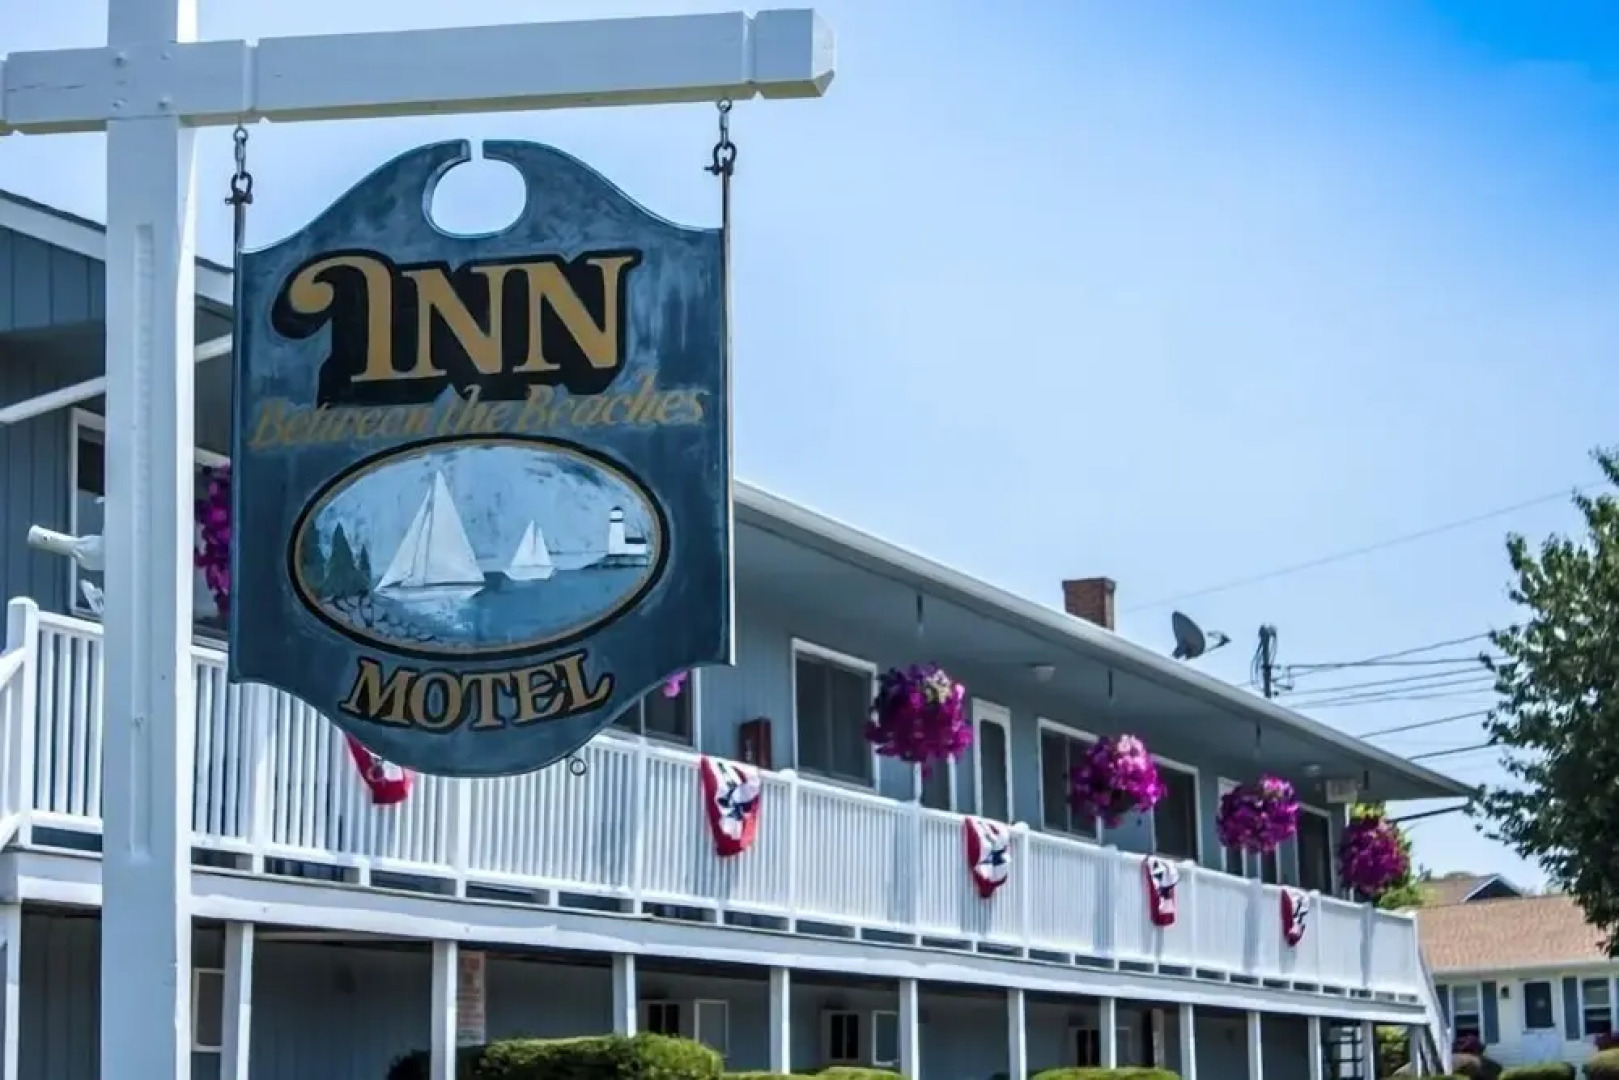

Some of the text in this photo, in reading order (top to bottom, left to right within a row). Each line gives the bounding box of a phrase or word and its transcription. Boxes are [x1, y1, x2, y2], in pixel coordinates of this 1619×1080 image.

[286, 253, 638, 386] INN
[249, 373, 708, 448] Between the Beaches
[341, 652, 612, 732] MOTEL
